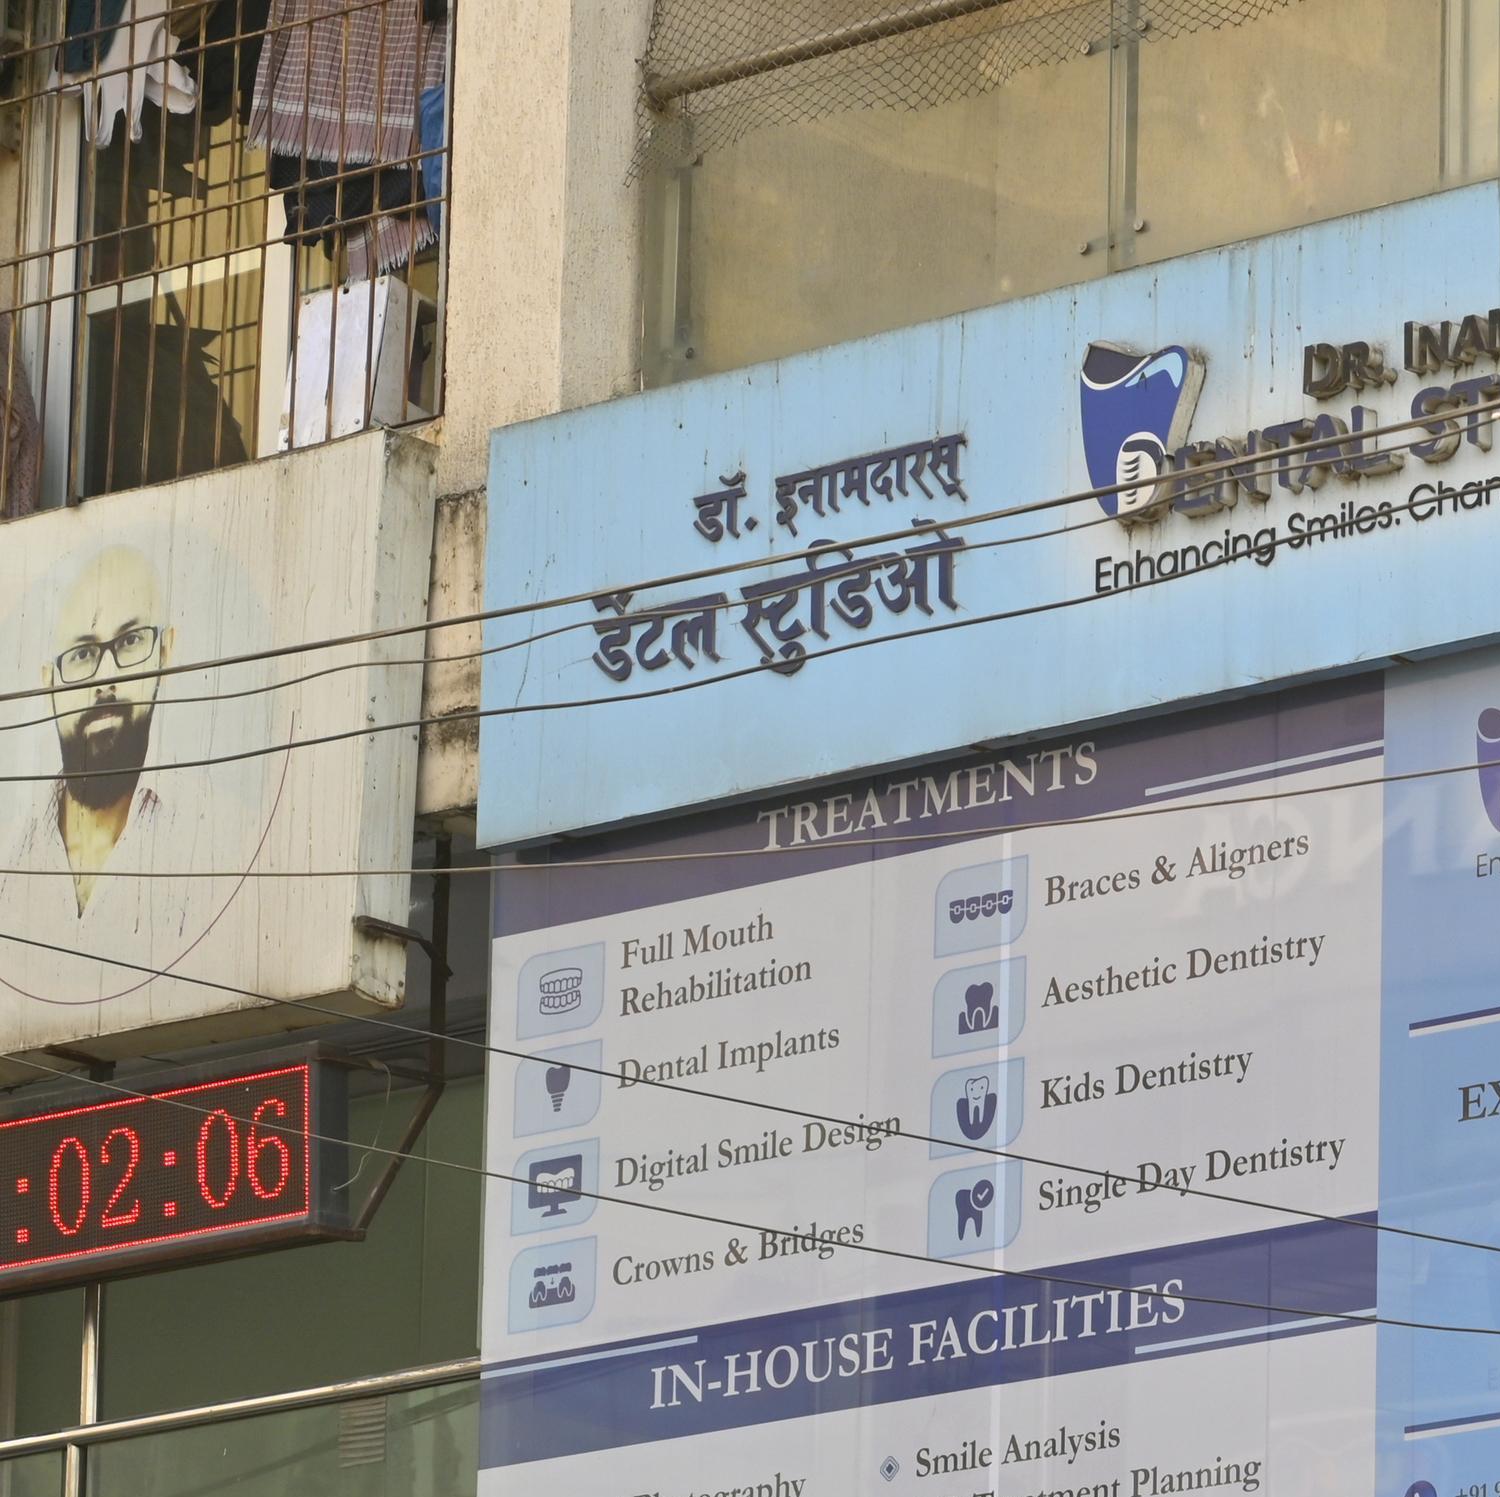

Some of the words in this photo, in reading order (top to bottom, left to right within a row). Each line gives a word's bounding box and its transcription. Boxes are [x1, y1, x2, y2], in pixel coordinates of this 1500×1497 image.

[694, 471, 758, 542] डॉ.
[776, 433, 968, 537] इनामदारस्
[1094, 522, 1278, 595] Enhancing
[1287, 499, 1400, 549] Smiles.
[757, 741, 1099, 854] TREATMENTS
[1045, 866, 1142, 907] Braces
[1151, 855, 1175, 885] &
[1185, 830, 1310, 882] Aligners
[621, 934, 676, 970] Full
[684, 911, 774, 961] Mouth
[1041, 957, 1179, 1008] Aesthetic
[1186, 932, 1327, 986] Dentistry
[620, 956, 813, 1017] Rehabilitation
[617, 1045, 710, 1091] Dental
[716, 1023, 841, 1075] Implants
[1040, 1074, 1107, 1110] Kids
[1114, 1047, 1254, 1102] Dentistry
[615, 1142, 710, 1191] Digital
[717, 1130, 794, 1173] Smile
[802, 1112, 902, 1158] Design
[611, 1243, 715, 1288] Crowns
[725, 1238, 748, 1267] &
[758, 1217, 865, 1260] Bridges
[650, 1328, 895, 1412] IN-HOUSE
[906, 1278, 1186, 1369] FACILITIES
